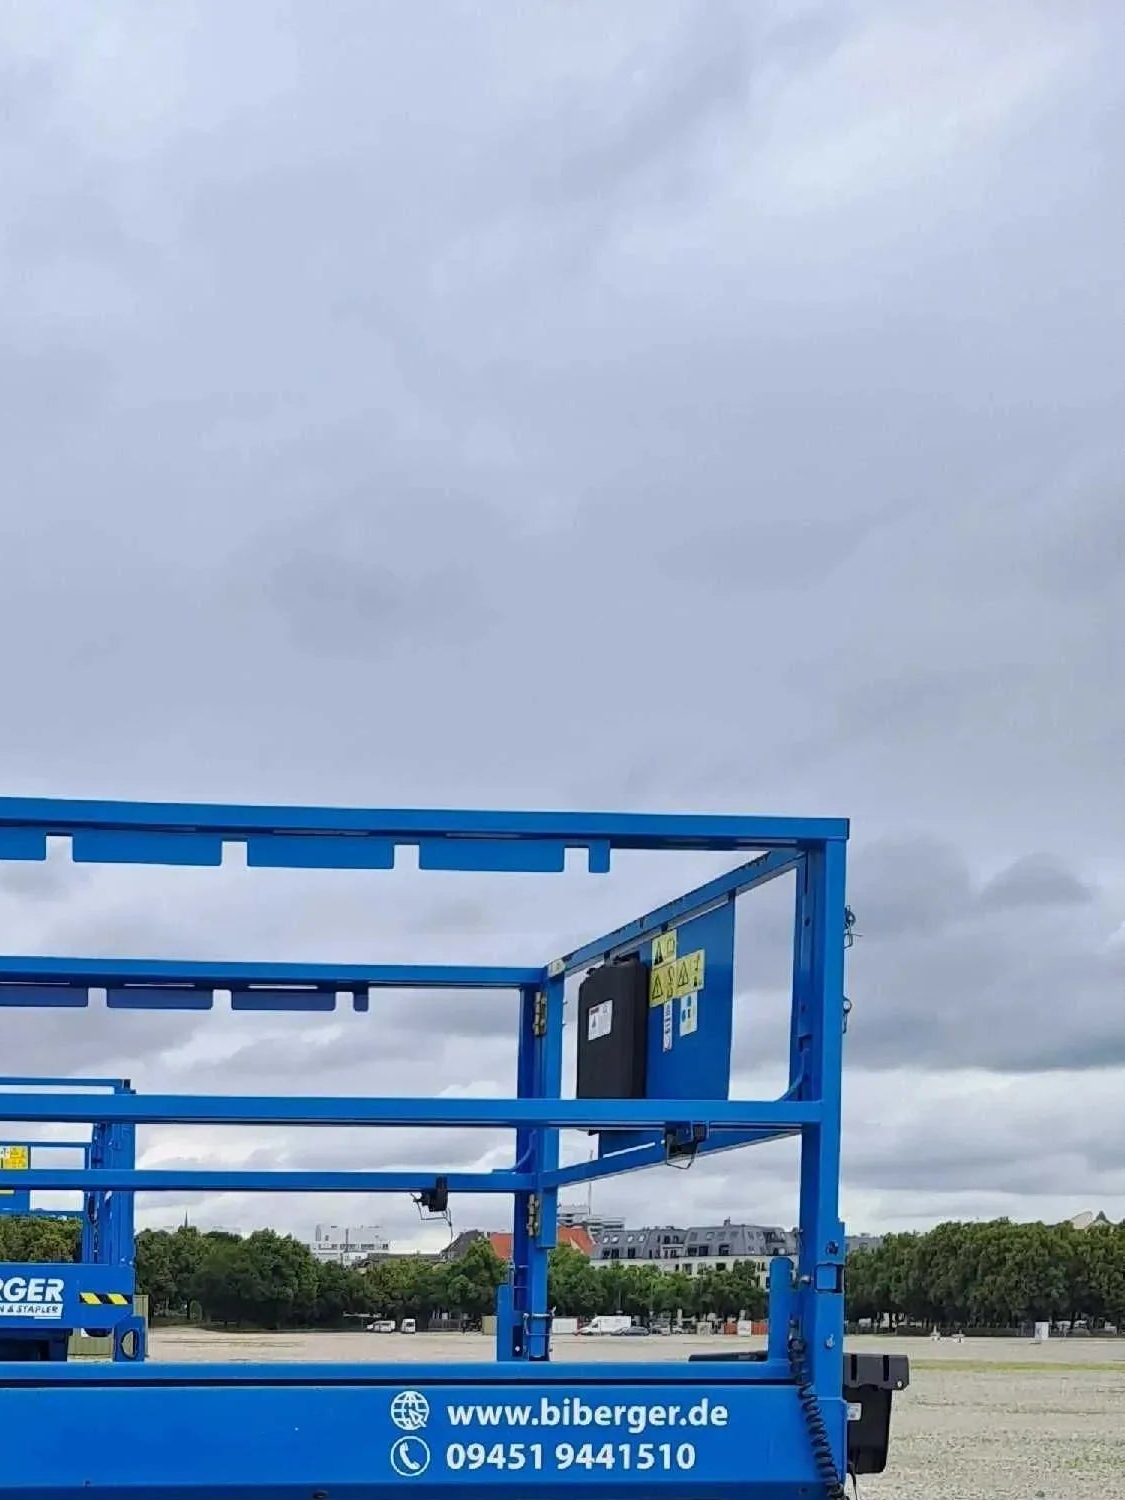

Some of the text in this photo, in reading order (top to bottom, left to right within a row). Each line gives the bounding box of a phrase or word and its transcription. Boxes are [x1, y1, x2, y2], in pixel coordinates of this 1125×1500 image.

[447, 1397, 728, 1434] www.biberger.de
[446, 1443, 696, 1470] 09451 9441510
